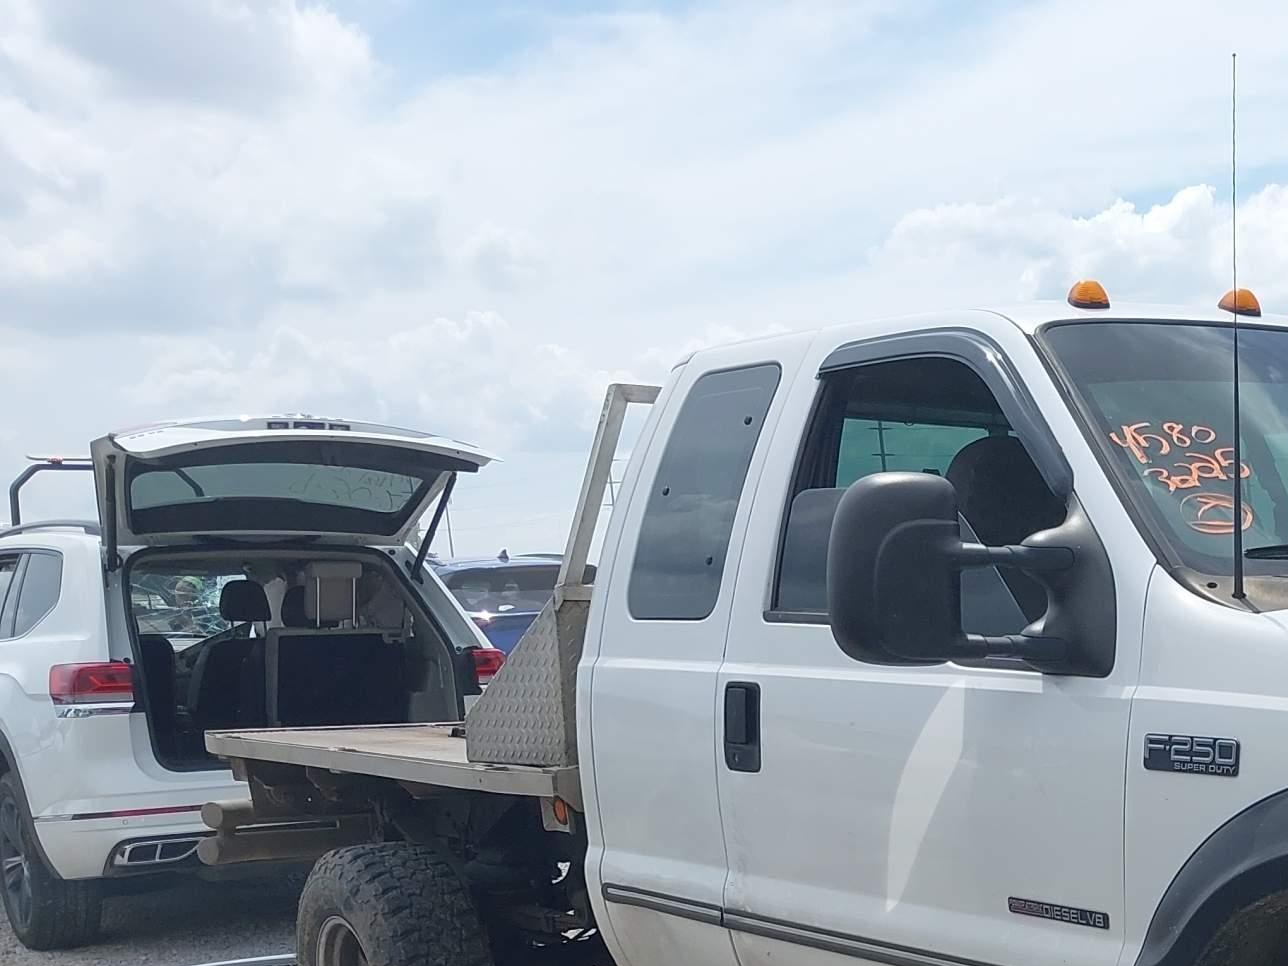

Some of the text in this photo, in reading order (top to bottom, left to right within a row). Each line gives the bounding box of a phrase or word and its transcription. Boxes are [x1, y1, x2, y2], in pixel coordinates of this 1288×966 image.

[1109, 421, 1216, 464] 4580
[1143, 447, 1251, 494] 3225
[1173, 761, 1236, 775] SUPER DUTY
[1042, 904, 1087, 924] DIESEL
[1086, 911, 1105, 928] V8
